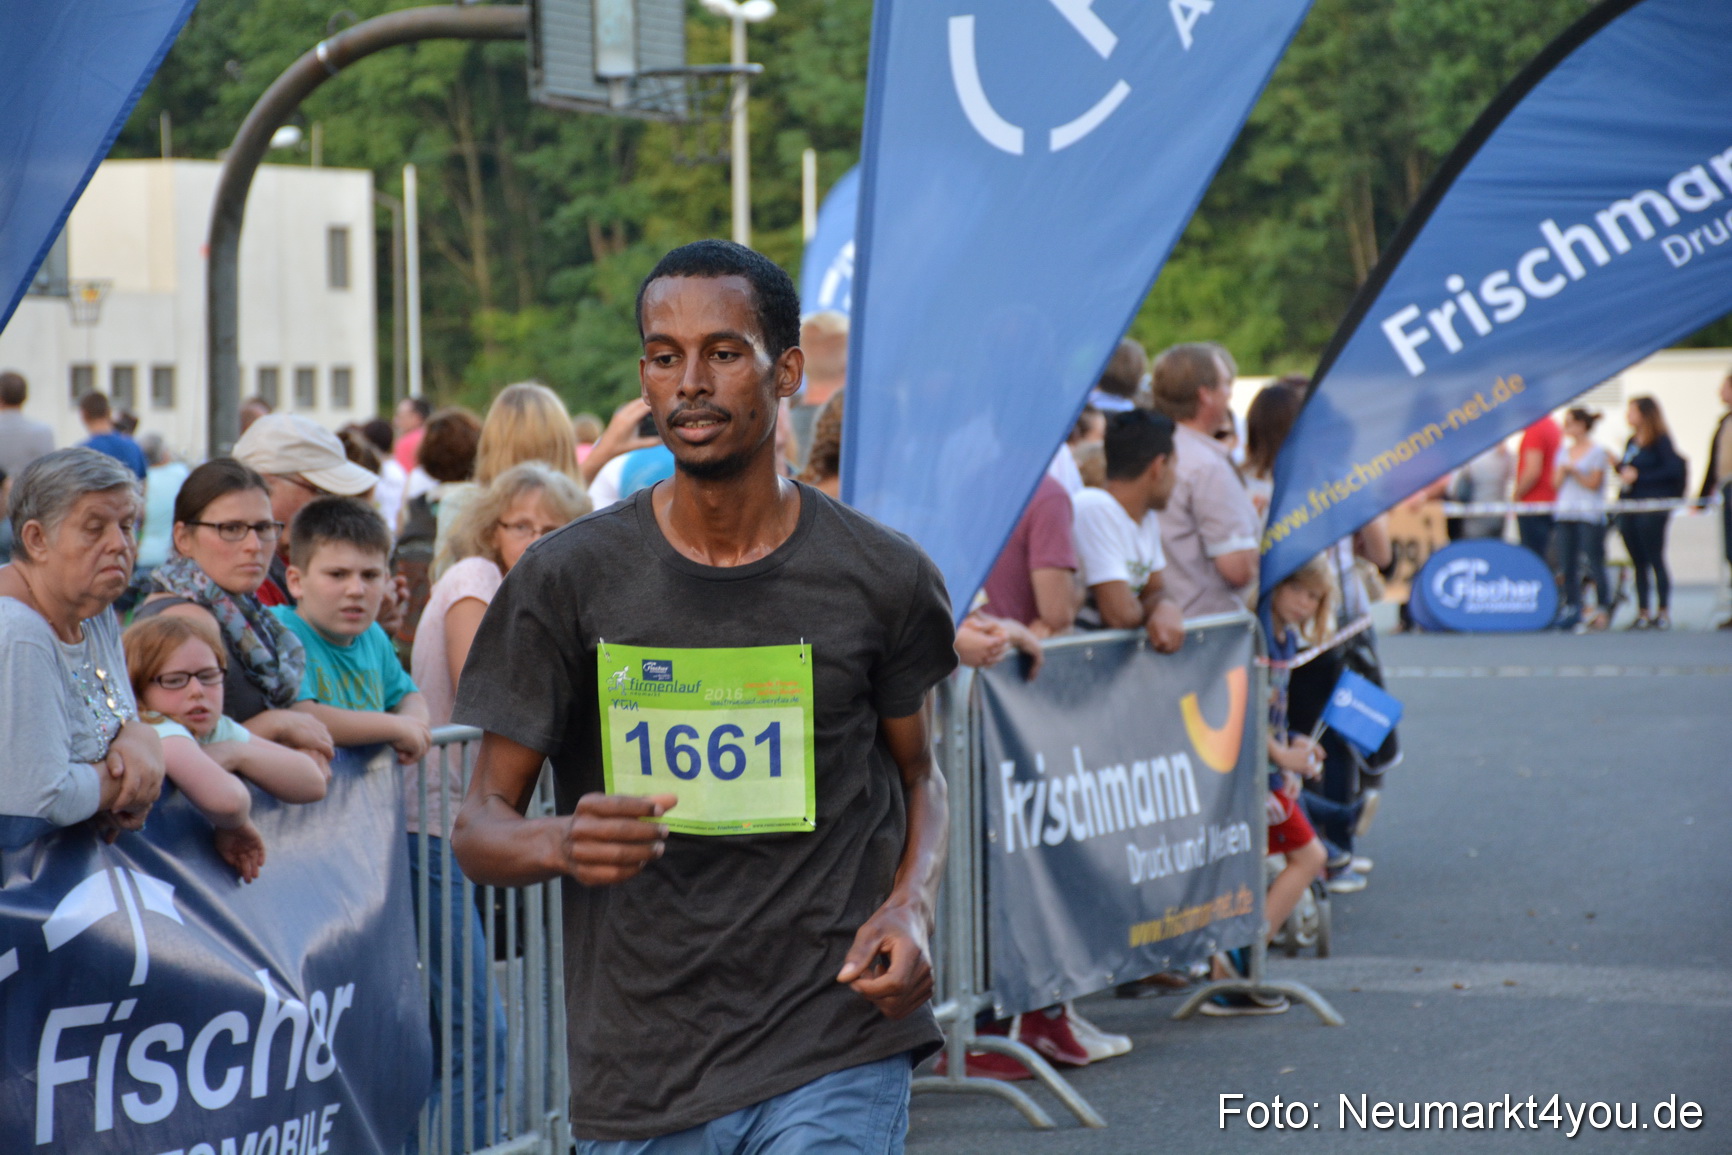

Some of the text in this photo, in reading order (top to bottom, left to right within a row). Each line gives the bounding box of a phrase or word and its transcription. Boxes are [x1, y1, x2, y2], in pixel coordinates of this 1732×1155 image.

[630, 677, 702, 693] firmenlauf
[704, 688, 743, 700] 2016
[625, 721, 782, 781] 1661
[1000, 746, 1200, 853] Frischmann
[35, 968, 354, 1146] Fischer
